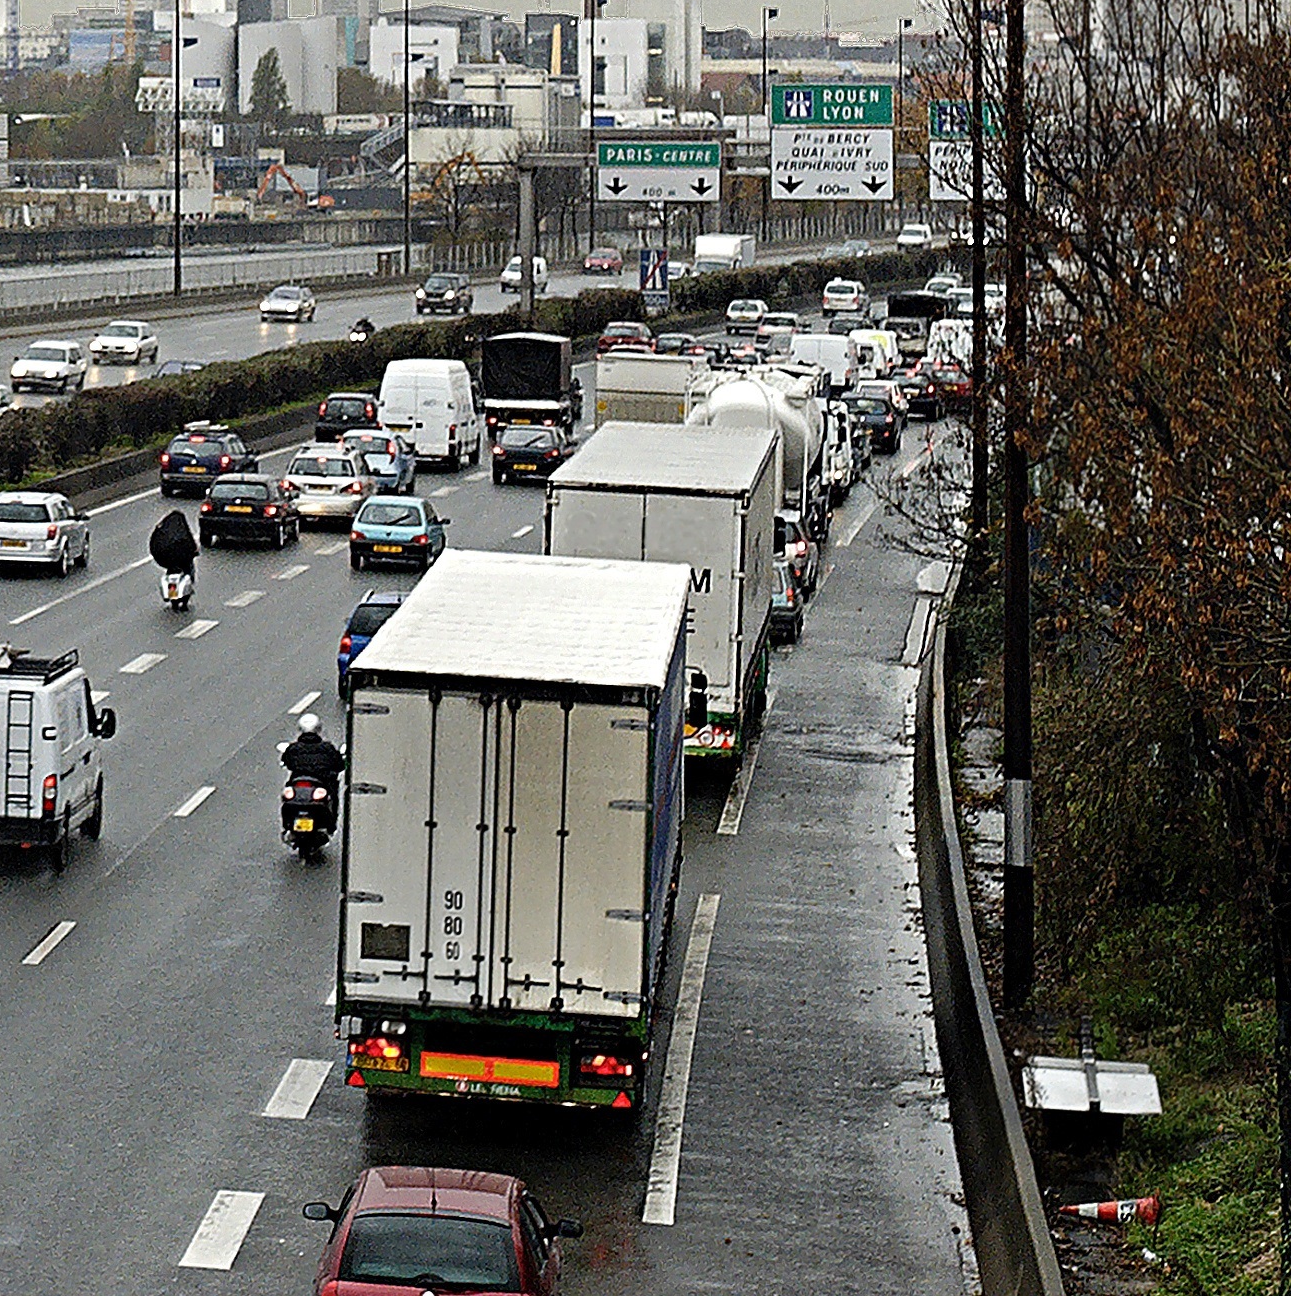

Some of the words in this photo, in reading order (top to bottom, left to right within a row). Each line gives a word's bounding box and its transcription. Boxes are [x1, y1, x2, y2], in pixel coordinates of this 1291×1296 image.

[823, 89, 880, 103] ROUEN
[823, 106, 864, 120] LYON
[827, 133, 871, 144] BERCY
[791, 147, 825, 158] QUAI
[864, 161, 888, 171] SUD
[444, 890, 463, 911] 90
[444, 915, 463, 936] 80
[446, 940, 460, 961] 60
